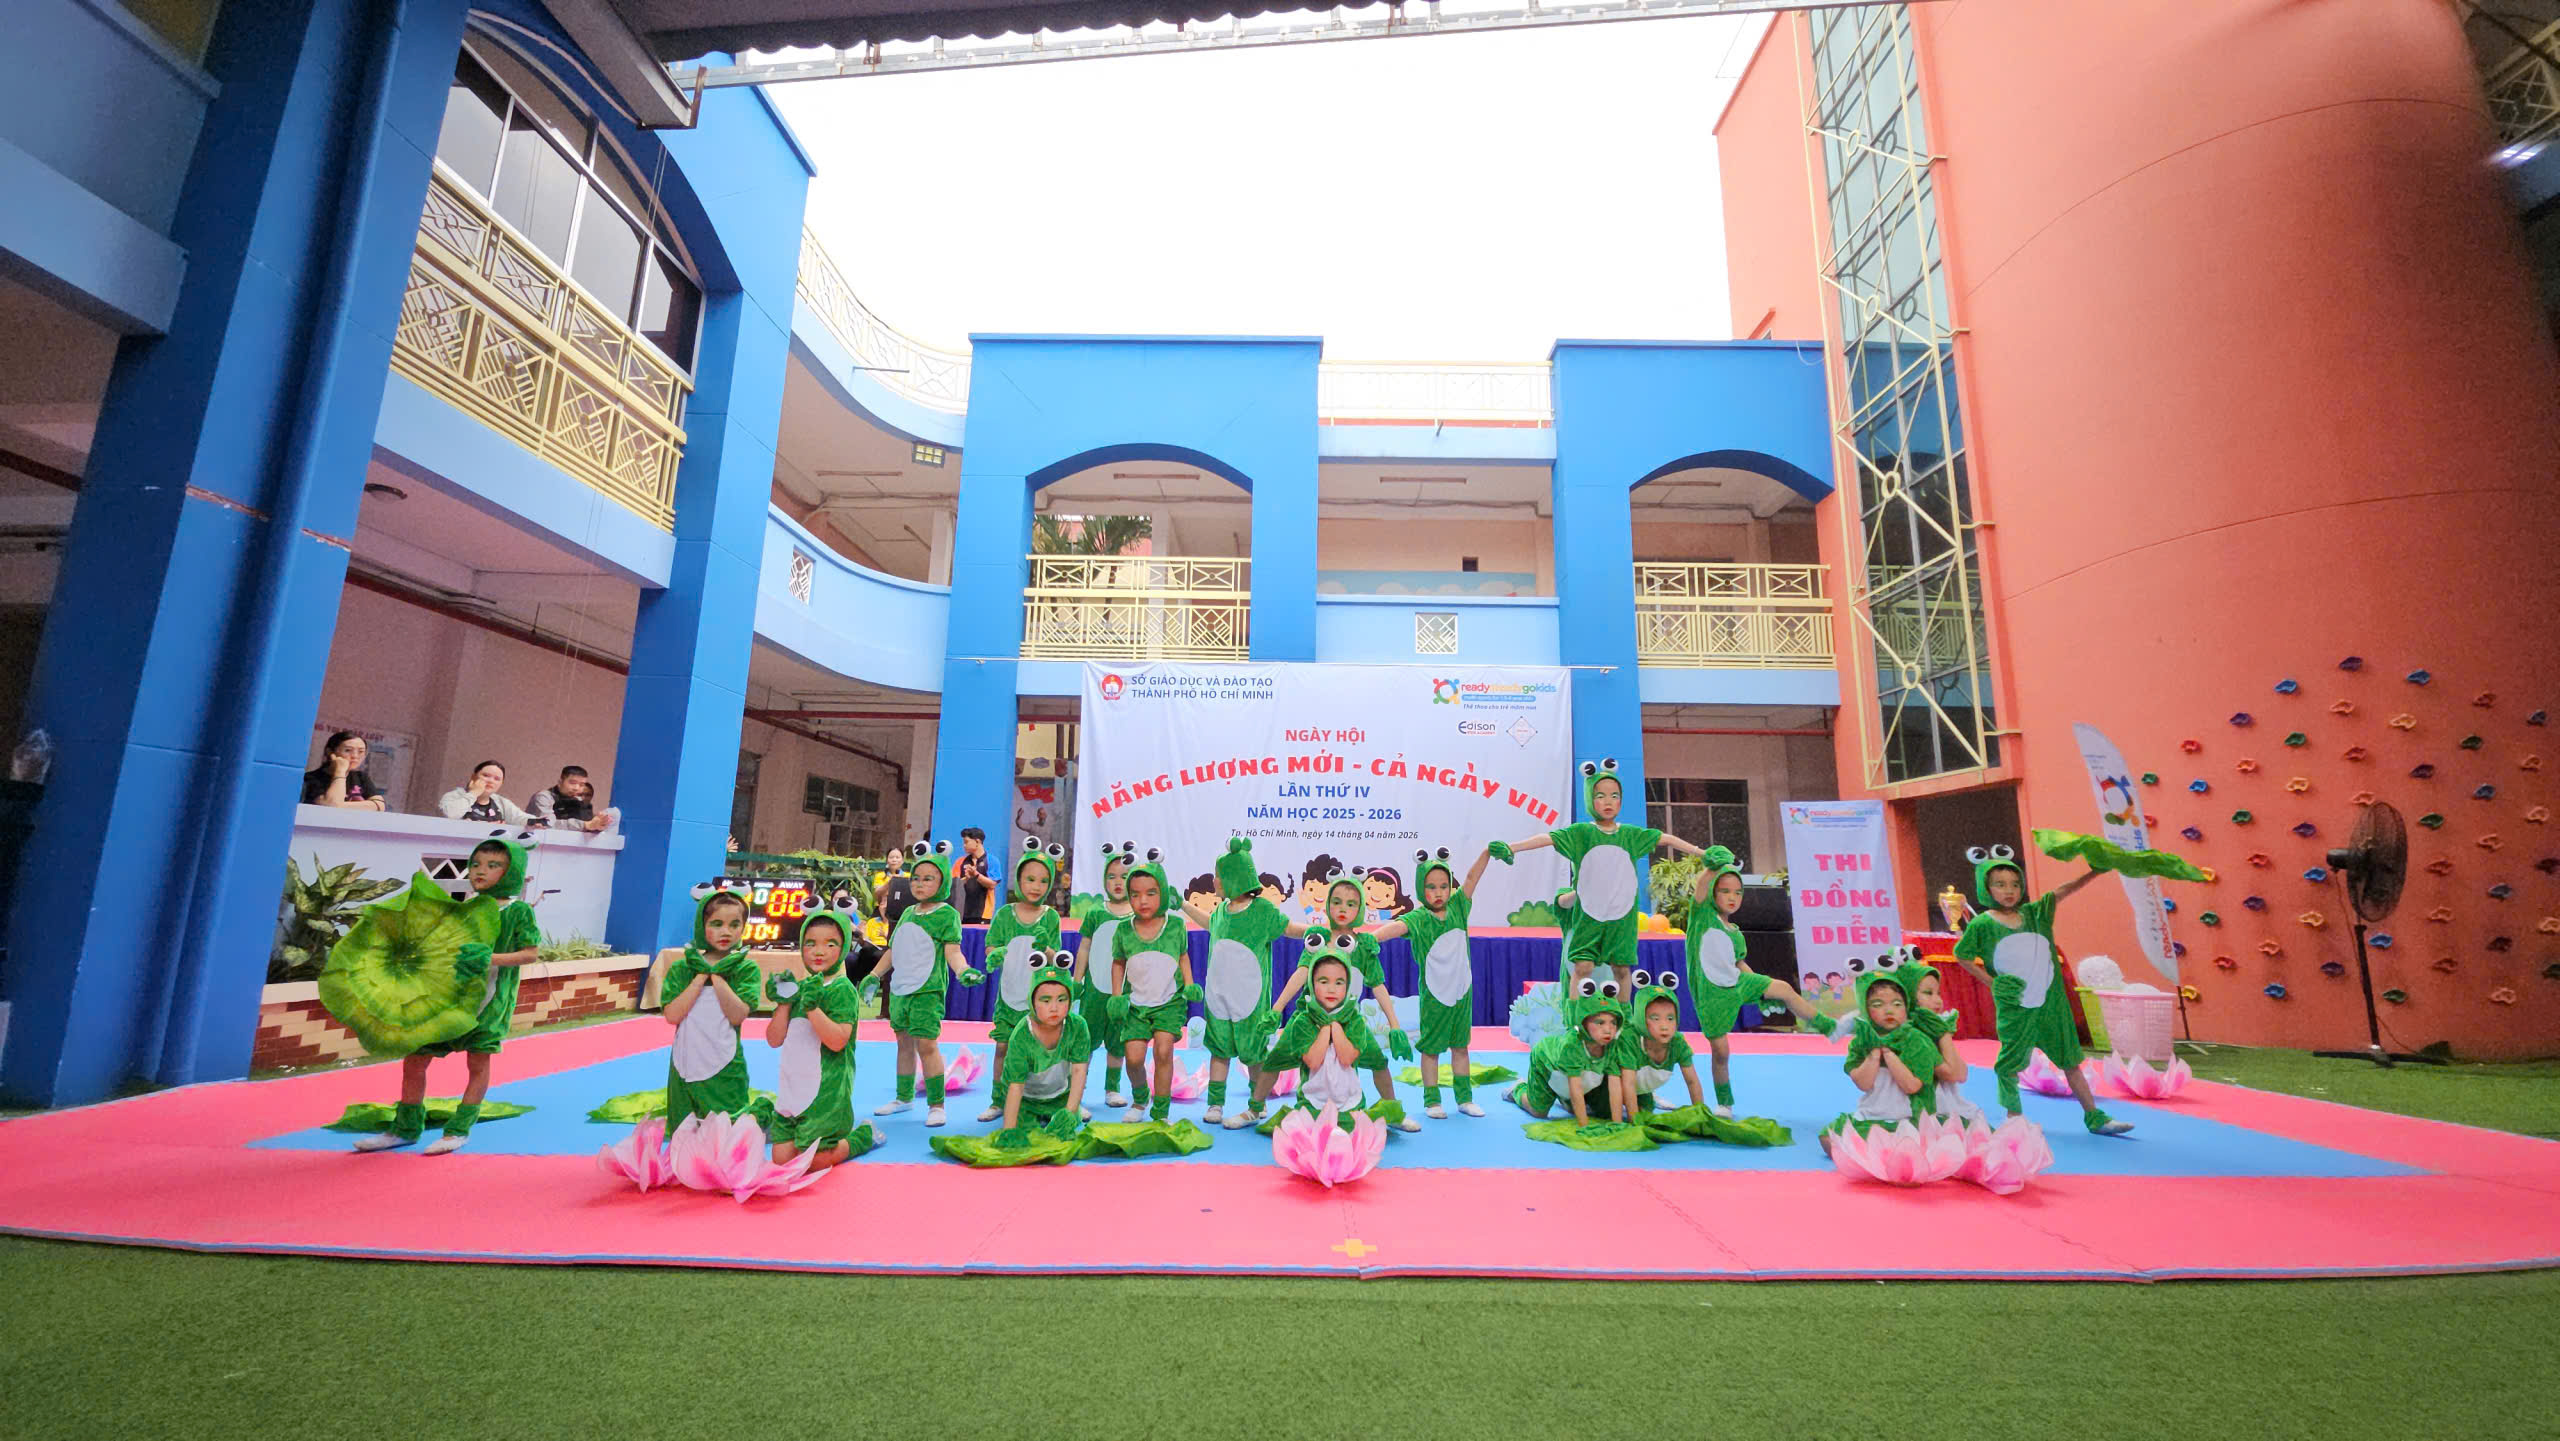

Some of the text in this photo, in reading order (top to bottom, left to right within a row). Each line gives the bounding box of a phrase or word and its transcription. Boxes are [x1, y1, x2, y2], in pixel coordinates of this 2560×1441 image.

[1131, 673, 1273, 689] SỞ GIÁO DỤC VÀ ĐÀO TẠO
[1132, 686, 1273, 700] THÀNH PHỐ HỒ CHÍ MINH
[1285, 726, 1365, 746] NGÀY HỘI
[1458, 721, 1496, 735] Edison
[1091, 774, 1174, 819] NĂNG
[1179, 757, 1279, 785] LƯỢNG
[1287, 749, 1344, 773] MỚI
[1370, 752, 1408, 778] CẢ
[1416, 761, 1501, 799] NGÀY
[1507, 787, 1559, 826] VUI
[1278, 781, 1371, 798] LẦN THỨ IV
[1247, 804, 1283, 818] NĂM
[1287, 807, 1319, 822] HỌC
[1323, 807, 1356, 819] 2025
[1368, 808, 1402, 820] 2026
[1246, 828, 1258, 837] Hồ
[1260, 829, 1273, 837] Chí
[1276, 829, 1299, 838] Minh,
[1302, 830, 1323, 839] ngày
[1325, 830, 1335, 838] 14
[1337, 830, 1362, 840] tháng
[1365, 830, 1375, 838] 04
[1377, 830, 1396, 839] năm
[1398, 831, 1419, 839] 2026
[1813, 853, 1872, 871] THI
[778, 881, 804, 889] AWAY
[1801, 878, 1892, 908] ĐỒNG
[1811, 913, 1890, 944] DIỄN
